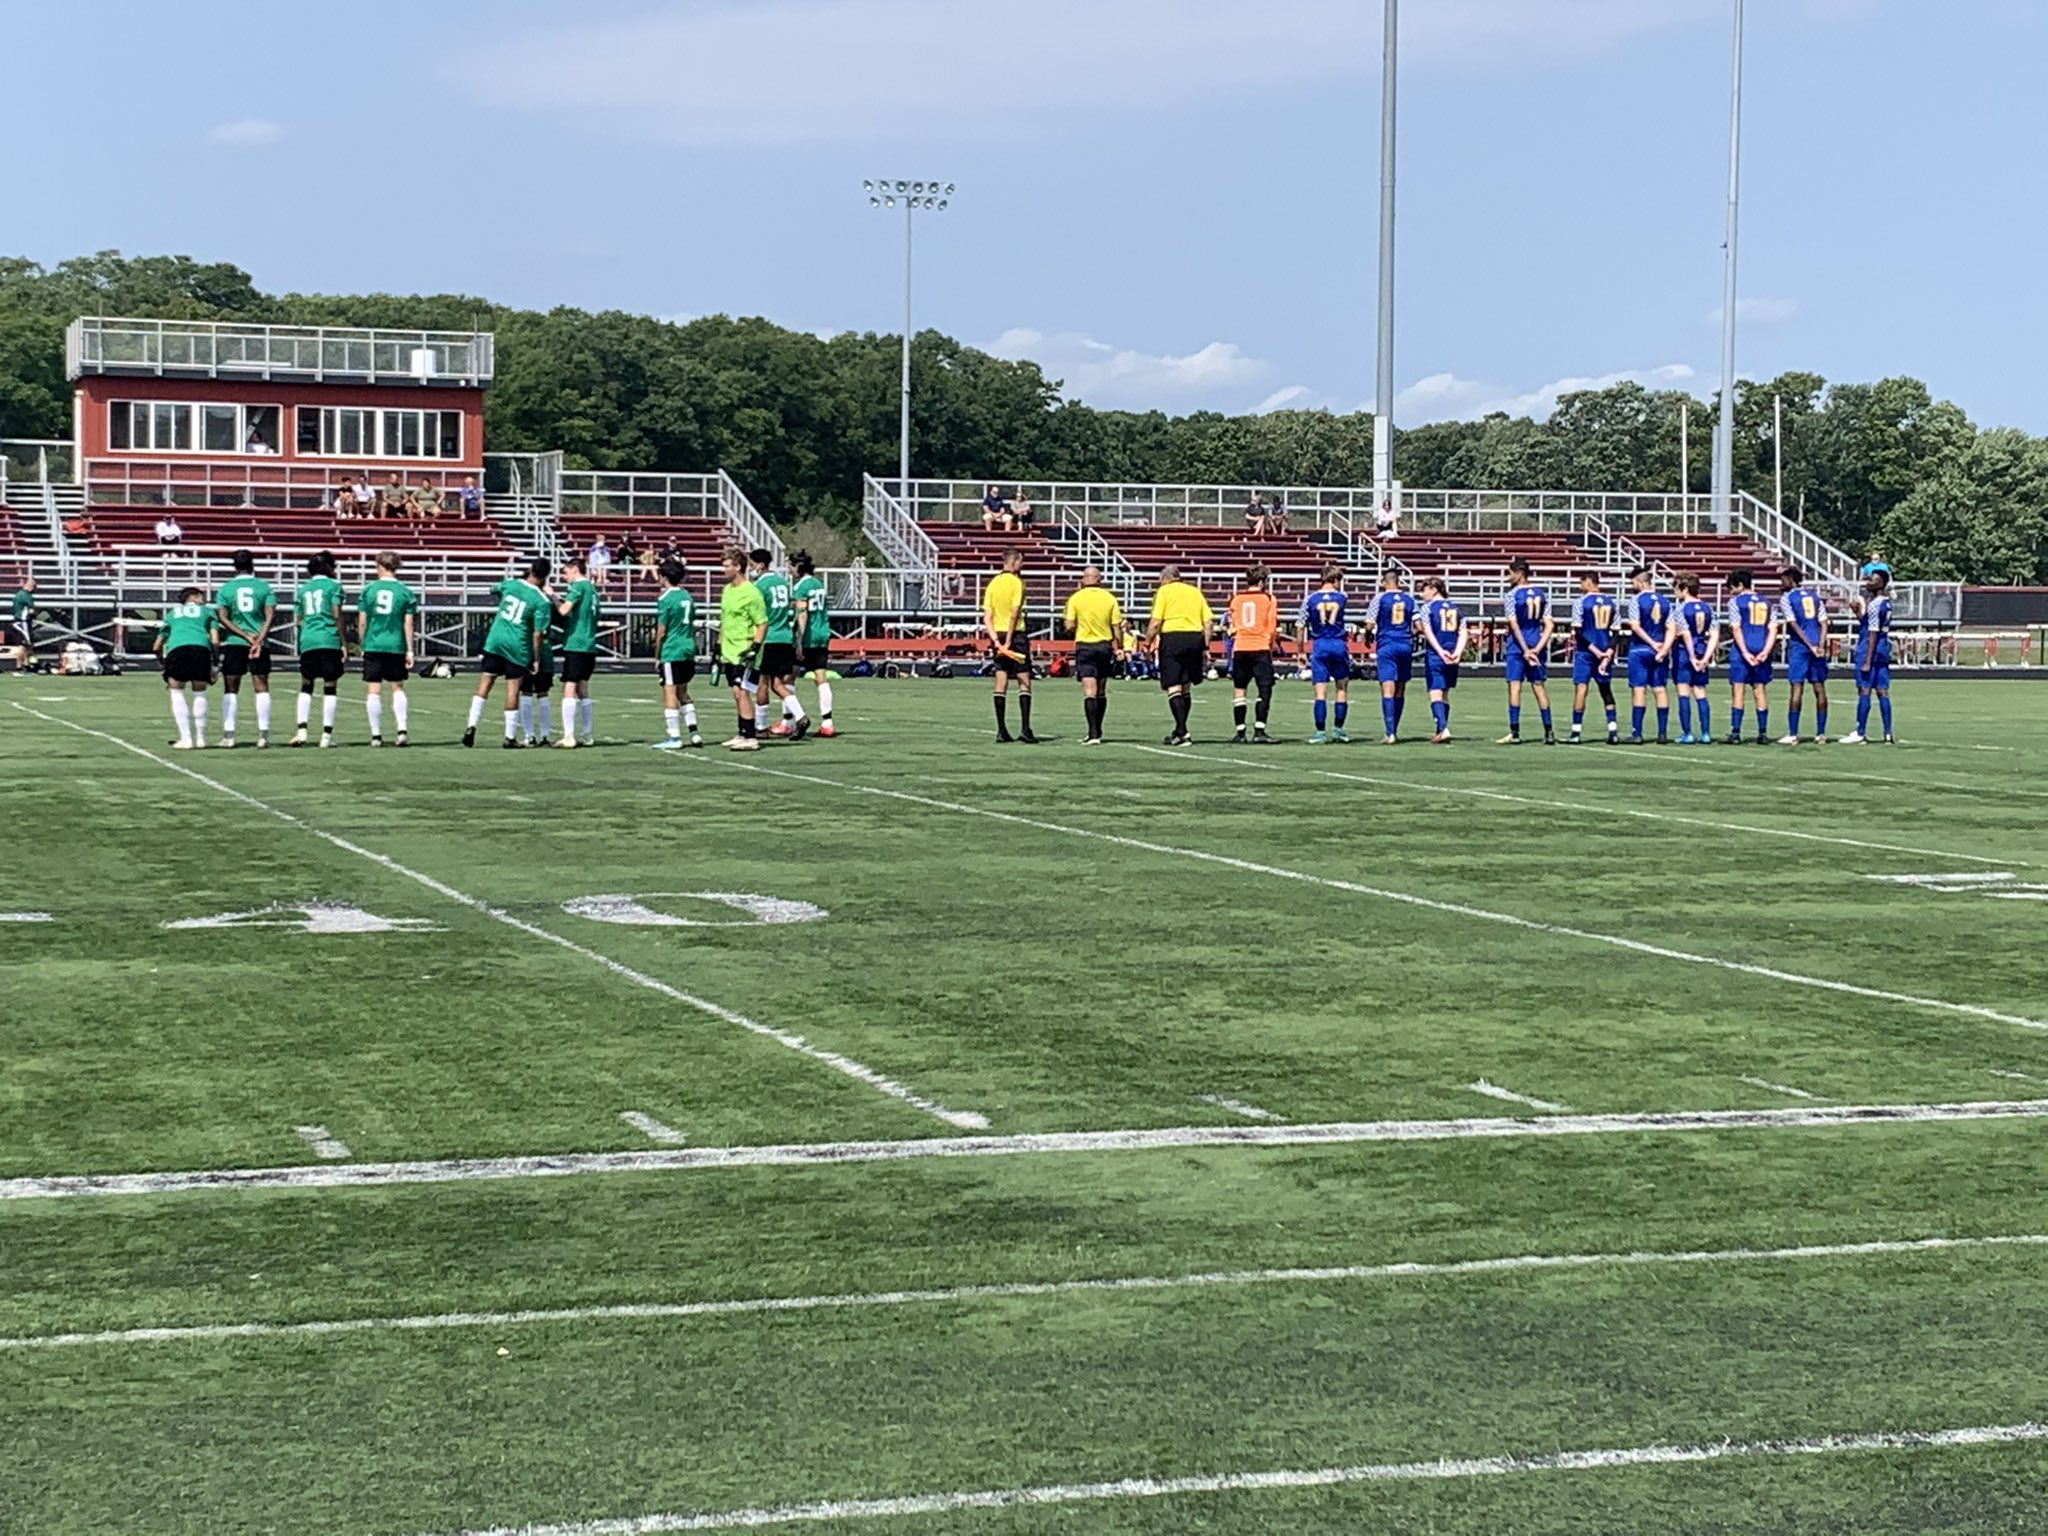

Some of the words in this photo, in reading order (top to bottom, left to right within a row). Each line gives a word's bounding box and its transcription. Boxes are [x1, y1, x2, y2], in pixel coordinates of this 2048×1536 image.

[236, 588, 254, 612] 6
[304, 589, 323, 615] 11
[376, 590, 393, 614] 9
[770, 585, 788, 608] 19
[1526, 596, 1541, 620] 11
[501, 595, 526, 624] 31
[681, 600, 691, 624] 7
[1241, 601, 1257, 628] 0
[1315, 602, 1341, 625] 17
[1439, 608, 1457, 632] 13
[1593, 605, 1612, 629] 10
[1650, 601, 1661, 624] 4
